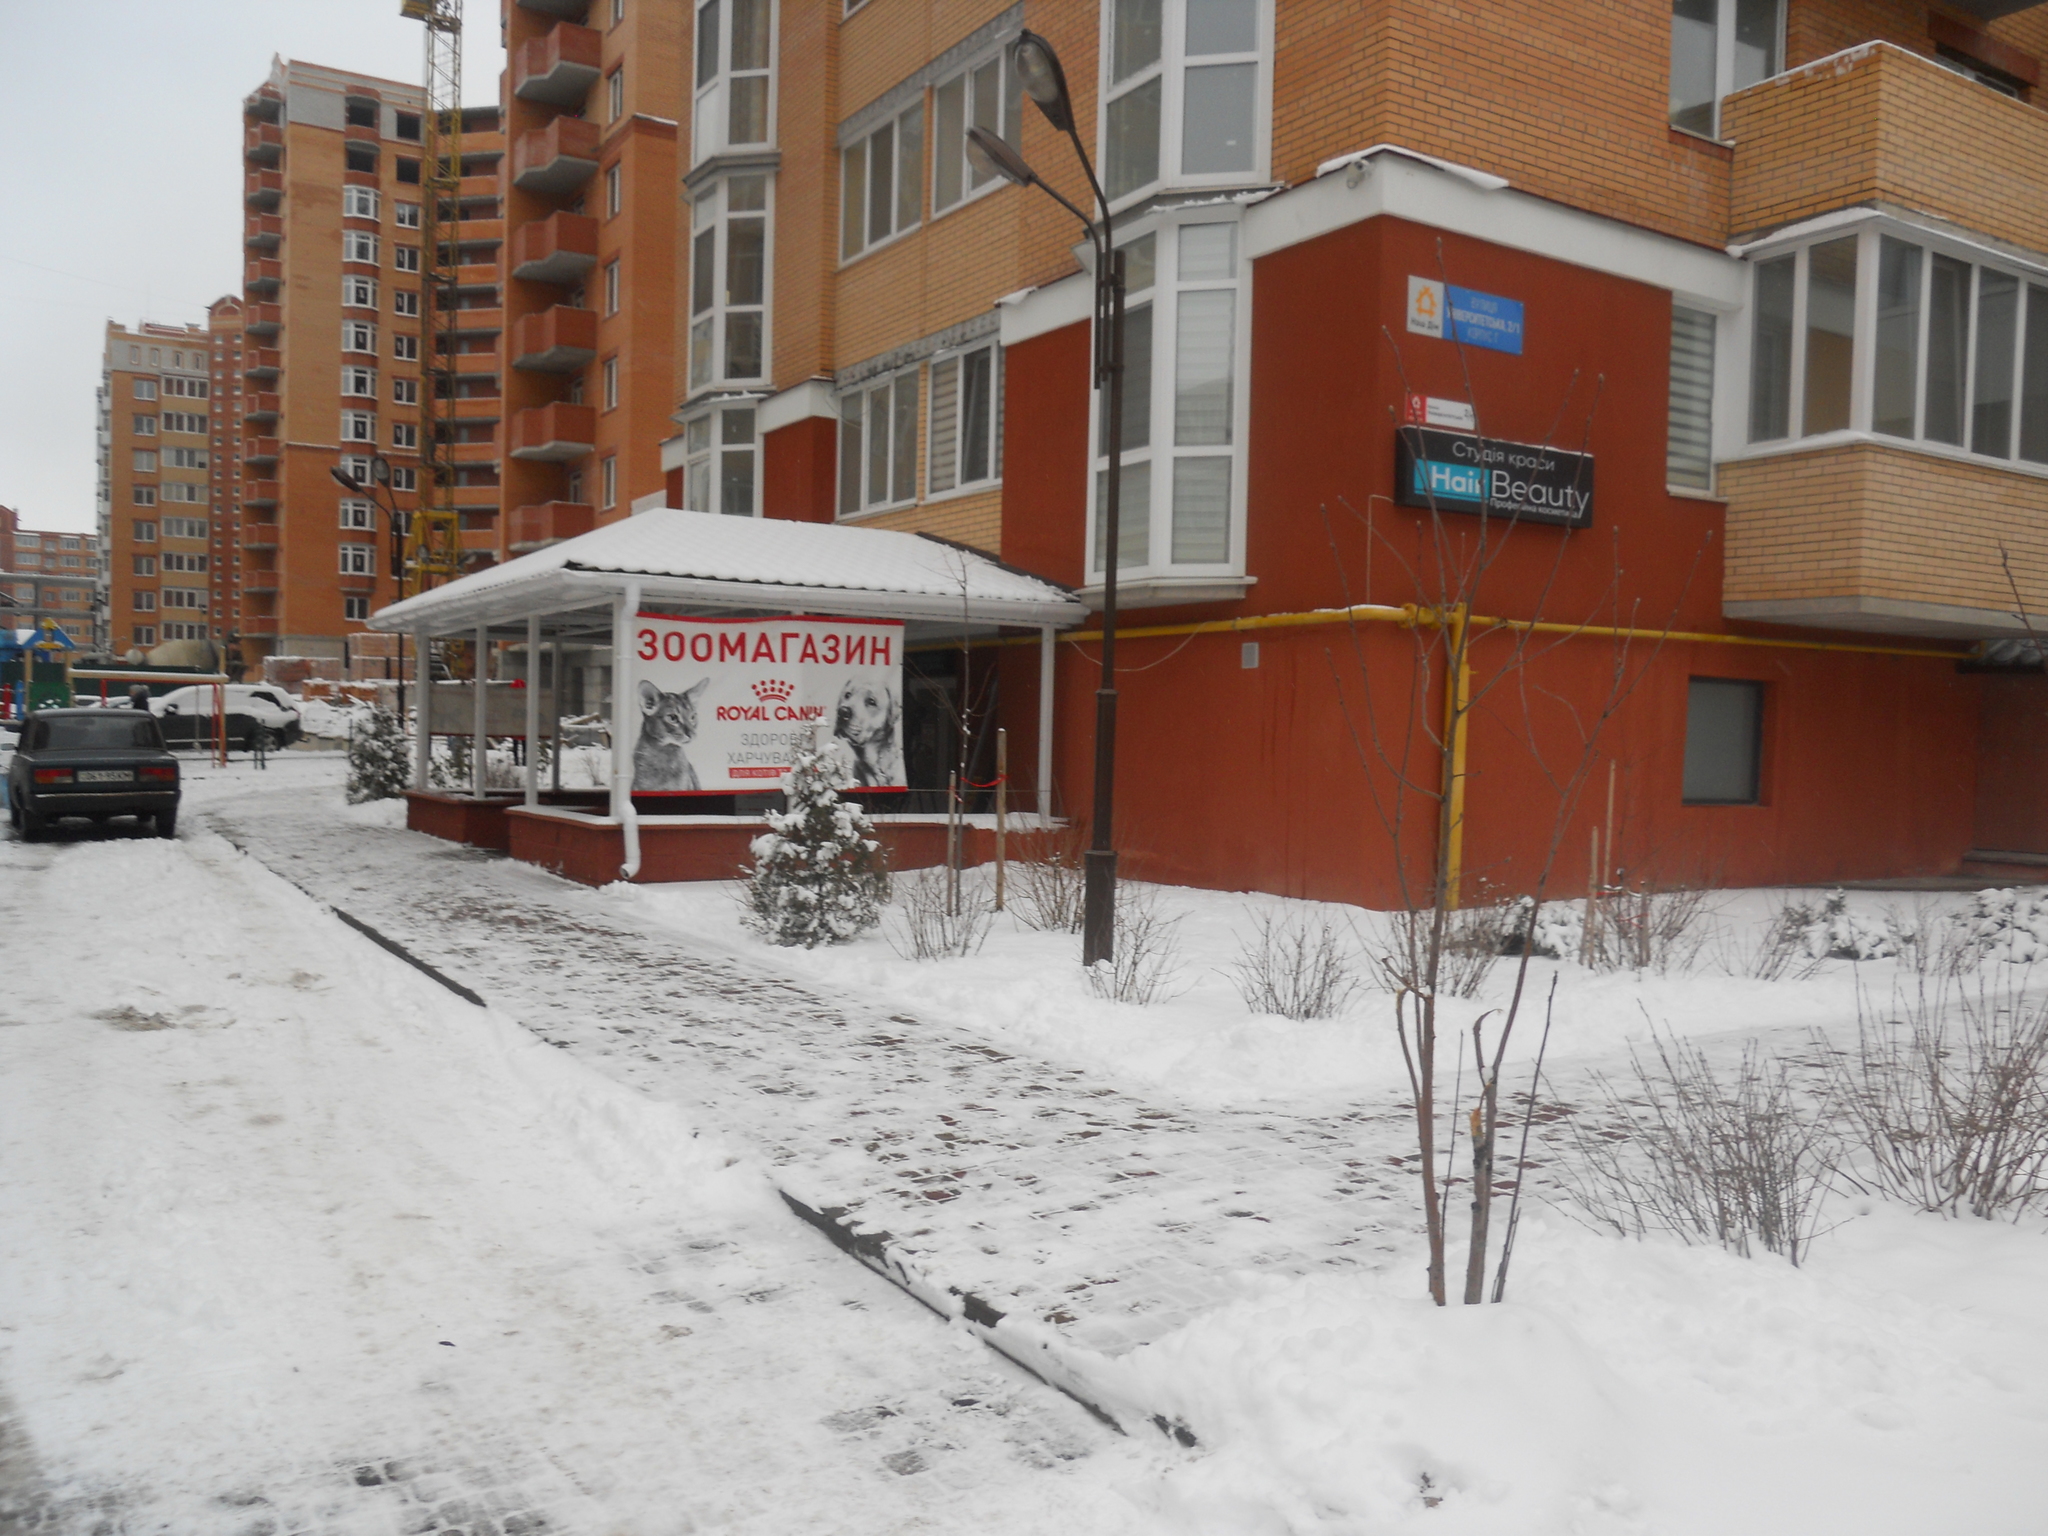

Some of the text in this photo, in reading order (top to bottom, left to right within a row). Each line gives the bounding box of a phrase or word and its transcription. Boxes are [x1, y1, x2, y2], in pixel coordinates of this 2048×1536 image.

[1452, 441, 1556, 471] Студія краси
[1491, 470, 1590, 519] Beauty
[638, 629, 891, 665] ЗООМАГАЗИН
[717, 706, 769, 721] ROYAL
